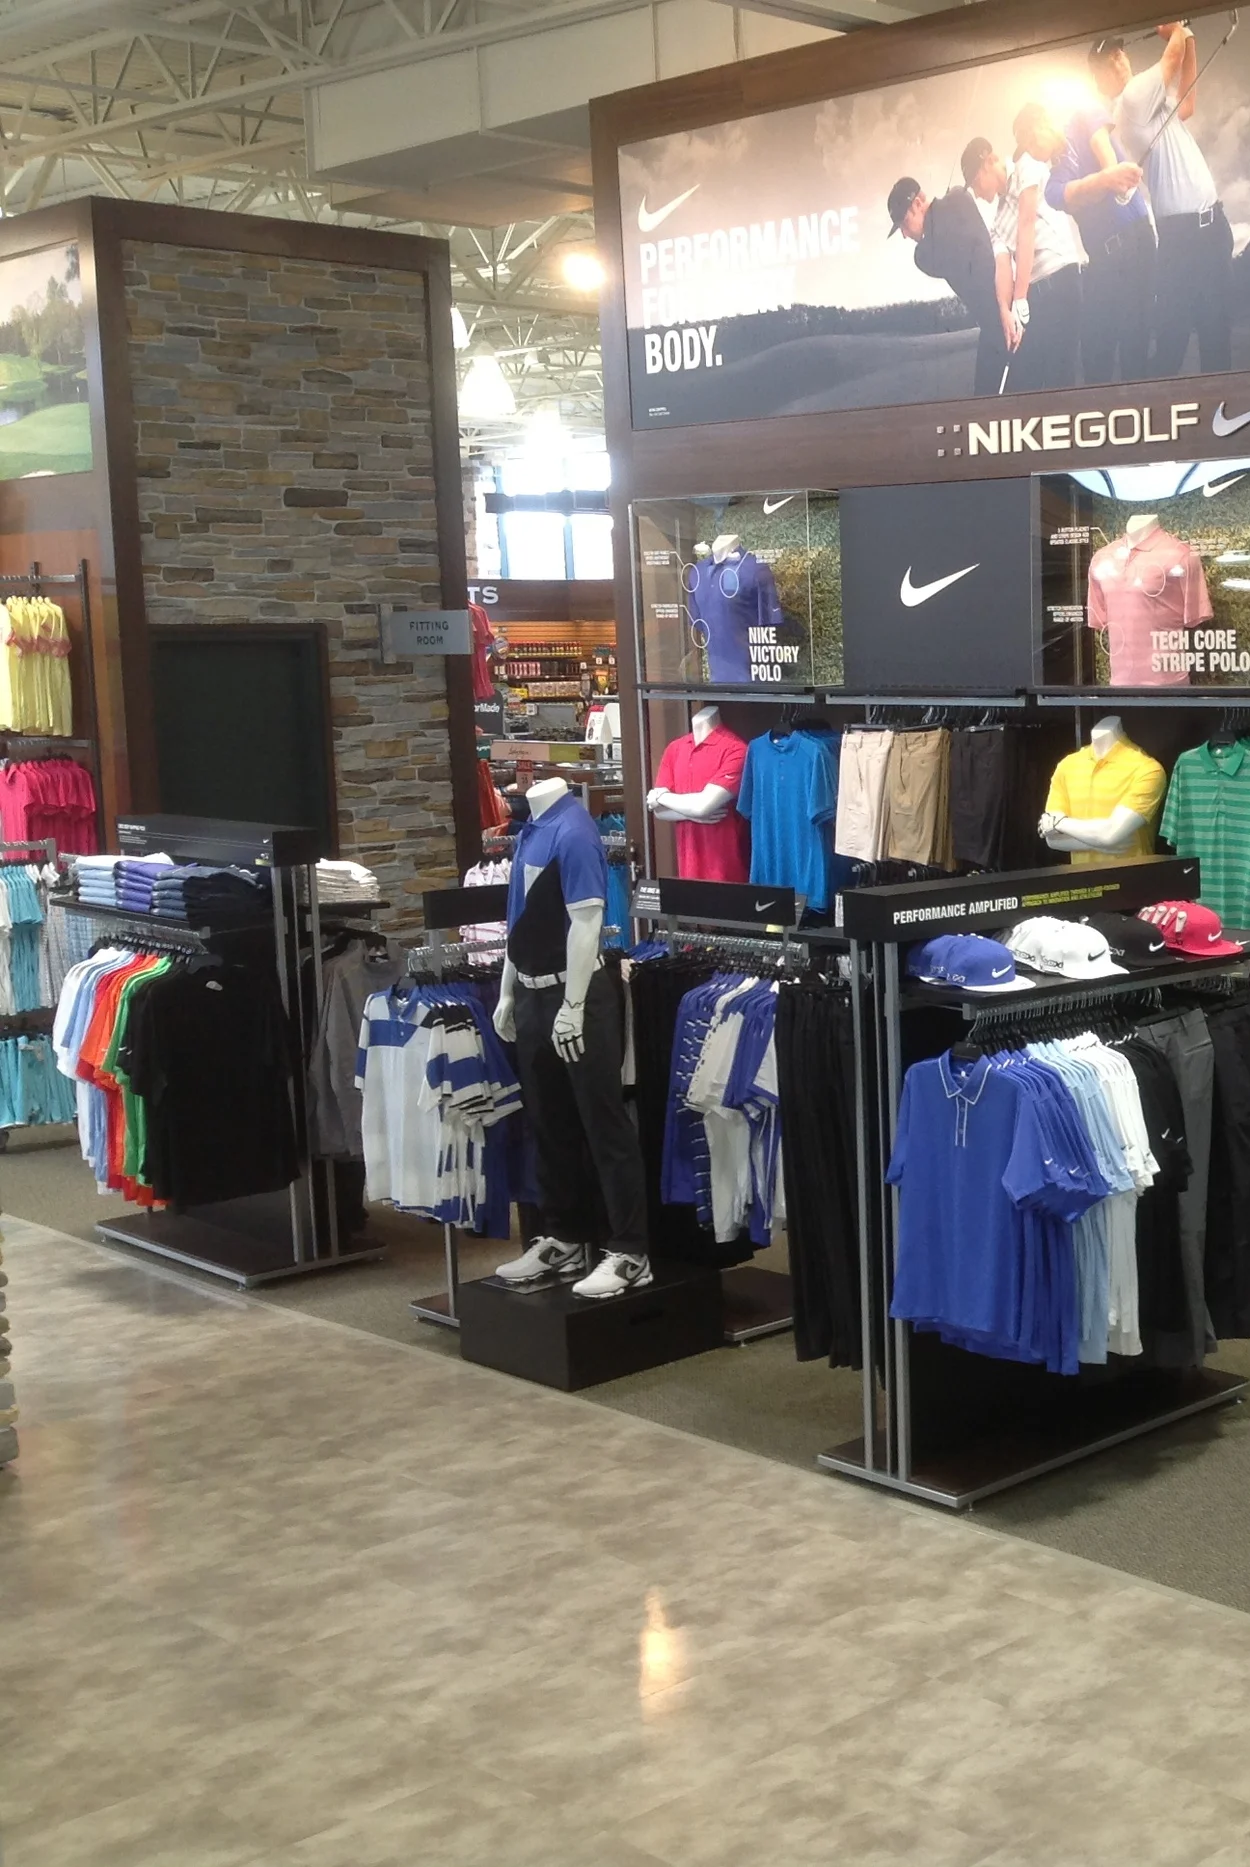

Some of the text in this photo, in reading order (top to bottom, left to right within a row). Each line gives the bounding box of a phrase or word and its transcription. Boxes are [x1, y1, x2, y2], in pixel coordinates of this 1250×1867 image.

[640, 206, 861, 285] PERFORMANCE
[644, 325, 723, 375] BODY.
[409, 621, 449, 631] FITTING
[748, 626, 777, 644] NIKE
[417, 635, 444, 645] ROOM
[1150, 629, 1237, 650] TECH CORE
[748, 646, 800, 664] VICTORY
[1151, 651, 1250, 673] STRIPE POLO
[751, 664, 782, 682] POLO
[893, 896, 1019, 925] PERFORMANCE AMPLIFIED
